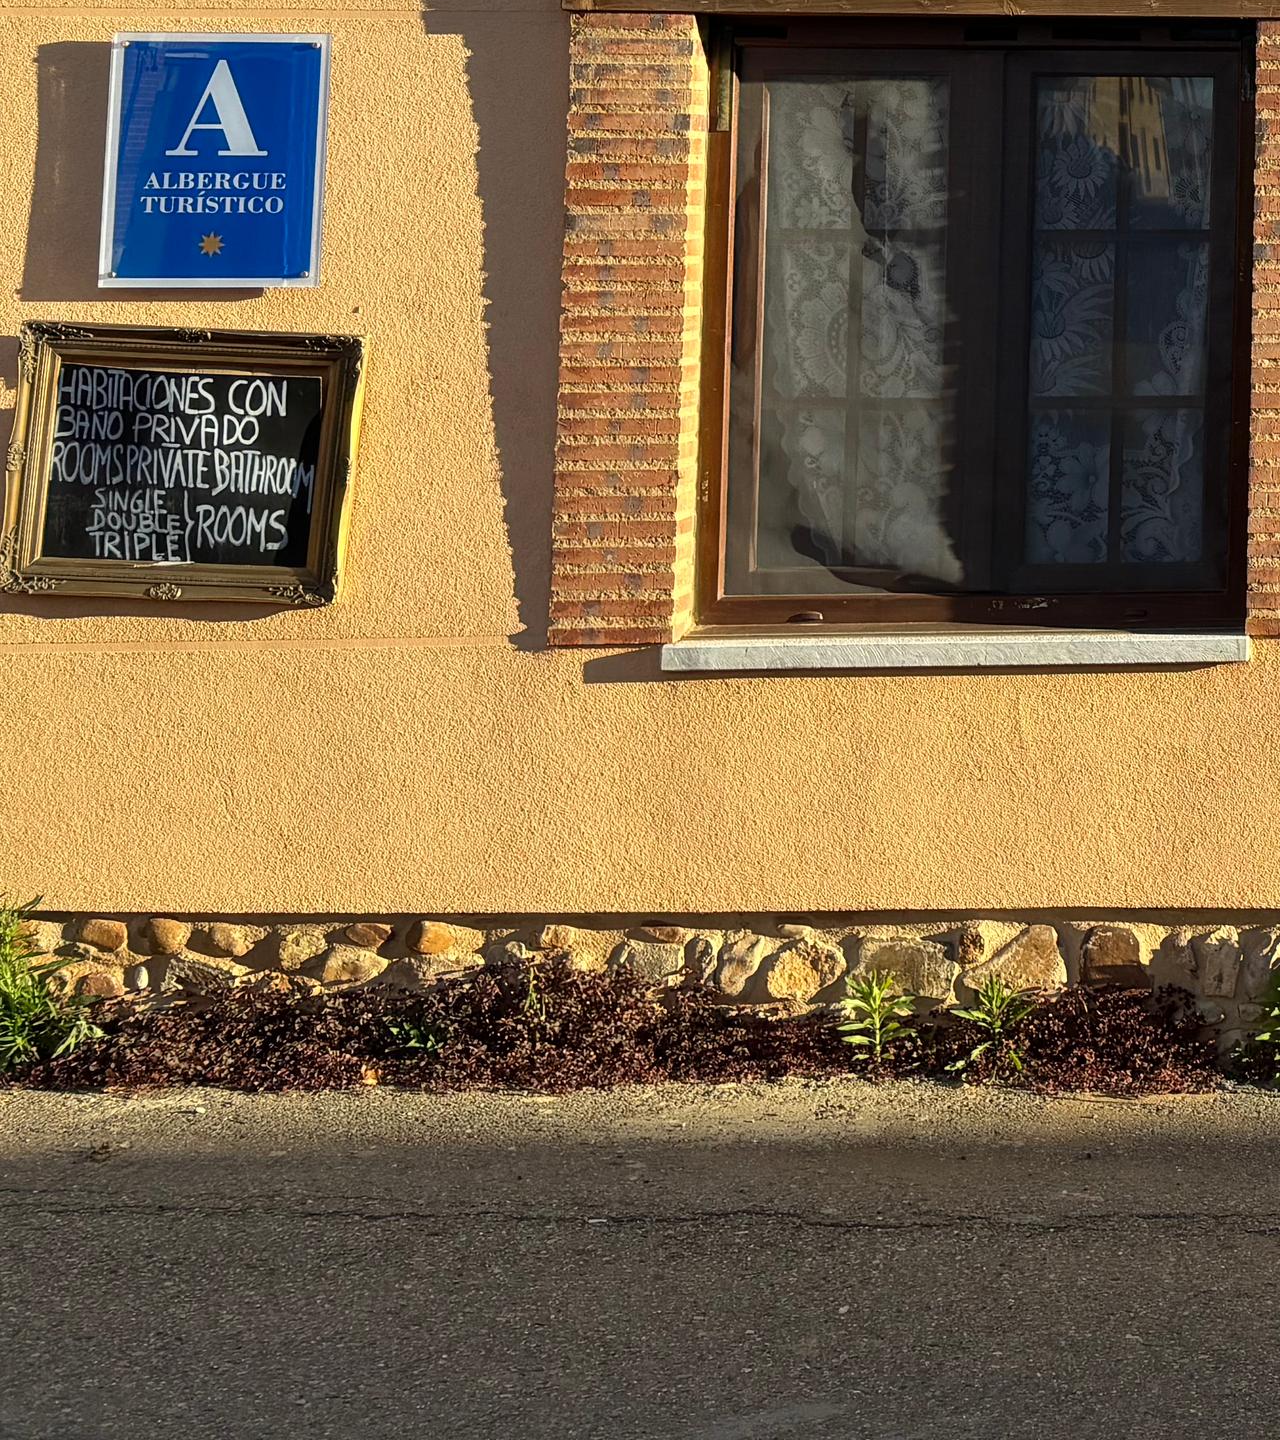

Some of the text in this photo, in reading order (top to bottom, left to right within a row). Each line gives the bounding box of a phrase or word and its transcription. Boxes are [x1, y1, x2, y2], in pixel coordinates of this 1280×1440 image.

[164, 59, 268, 157] A
[143, 171, 287, 191] ALBERGUE
[140, 190, 284, 214] TURÍSTICO
[58, 367, 288, 417] HABITACIONES CON
[132, 412, 259, 446] PRIVADO
[50, 441, 124, 486] ROOMS
[126, 444, 211, 490] PRIVATE
[91, 488, 167, 515] SINGLE
[86, 510, 183, 534] DOUBLE
[195, 504, 289, 552] ROOMS
[89, 531, 182, 561] TRIPLE
